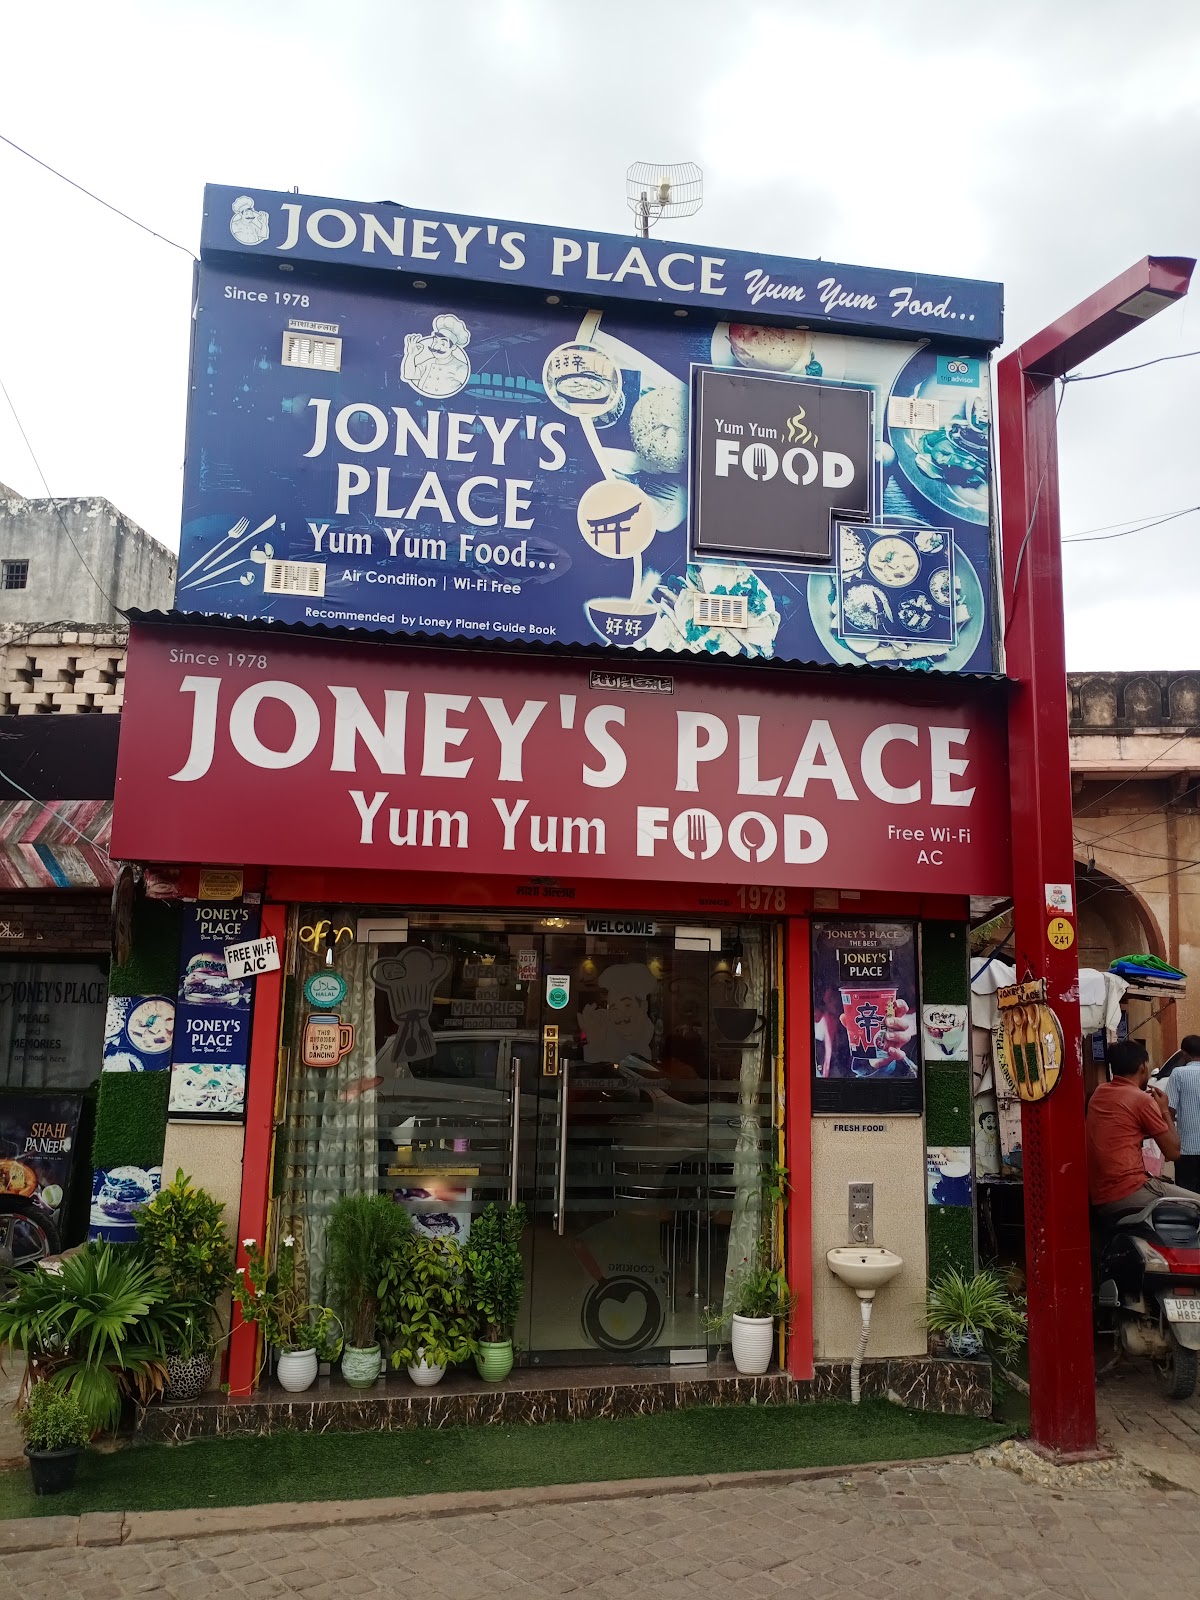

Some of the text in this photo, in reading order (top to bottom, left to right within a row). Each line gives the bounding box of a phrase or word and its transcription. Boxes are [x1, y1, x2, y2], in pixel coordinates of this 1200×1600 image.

[276, 203, 976, 322] JONEY'S PLACE Yum Yum Food...
[224, 285, 310, 308] Since 1978
[941, 375, 974, 384] tripadvisor
[303, 398, 567, 472] JONEY'S
[715, 418, 777, 439] Yum Yum
[715, 438, 855, 489] FOOD
[335, 462, 536, 530] PLACE
[308, 522, 557, 571] Yum Yum Food...
[341, 569, 522, 595] Air Condition Wi-Fi Free
[305, 606, 557, 636] Recommended by Loney Planet Guide Book
[606, 617, 642, 637] 好好
[169, 648, 268, 670] Since 1978
[168, 675, 977, 807] JONEY'S PLACE
[348, 790, 829, 865] Yum Yum FOOD
[887, 825, 972, 845] Free Wi-Fi
[916, 849, 943, 866] AC
[736, 885, 786, 911] 1978
[195, 907, 249, 921] JONEY'S
[200, 922, 242, 935] PLACE
[586, 919, 654, 934] WELCOME
[827, 930, 899, 939] JONEY'S PLACE
[1057, 922, 1064, 932] P
[1053, 935, 1069, 945] 241
[228, 941, 275, 963] FREE WI-FI
[520, 955, 536, 963] 2017
[843, 952, 887, 965] JONEY'S
[243, 957, 267, 974] A/C
[849, 966, 883, 977] PLACE
[12, 981, 105, 1006] JONEY'S PLACE
[313, 980, 339, 991] حلال
[477, 989, 498, 999] and
[451, 1001, 524, 1015] MEMORIES
[18, 1014, 50, 1023] MEALS
[186, 1019, 241, 1033] JONEY'S
[464, 1018, 491, 1028] made
[492, 1018, 517, 1028] here
[12, 1038, 61, 1049] MEMORIES
[191, 1033, 233, 1047] PLACE
[30, 1122, 68, 1139] SHAHI
[833, 1124, 884, 1132] FRESH FOOD
[24, 1136, 69, 1154] PANEER
